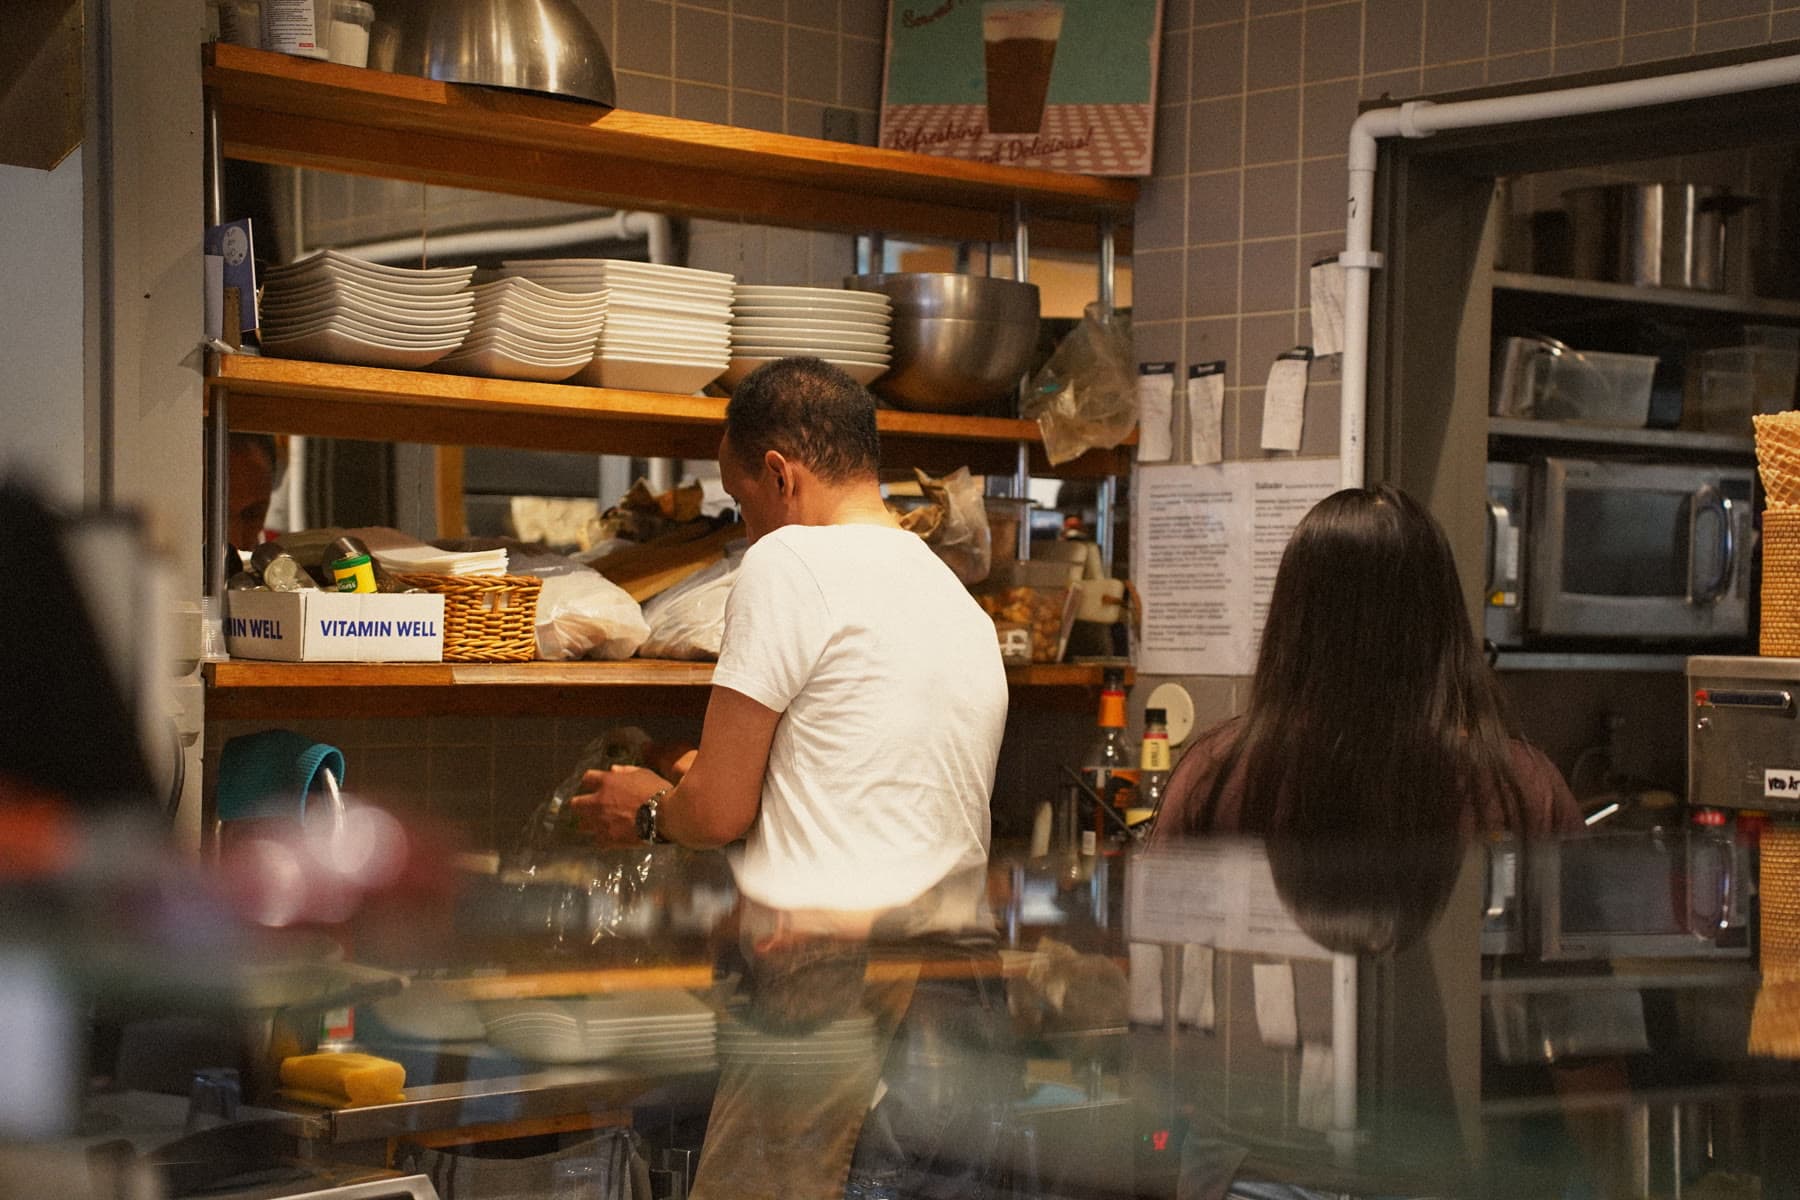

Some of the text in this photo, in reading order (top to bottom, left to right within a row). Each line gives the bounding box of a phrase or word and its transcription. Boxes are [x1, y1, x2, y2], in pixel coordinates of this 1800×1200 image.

[894, 122, 984, 153] Refreshing
[1008, 127, 1094, 161] Delicious!
[250, 619, 283, 640] WELL
[320, 620, 437, 637] VITAMIN WELL
